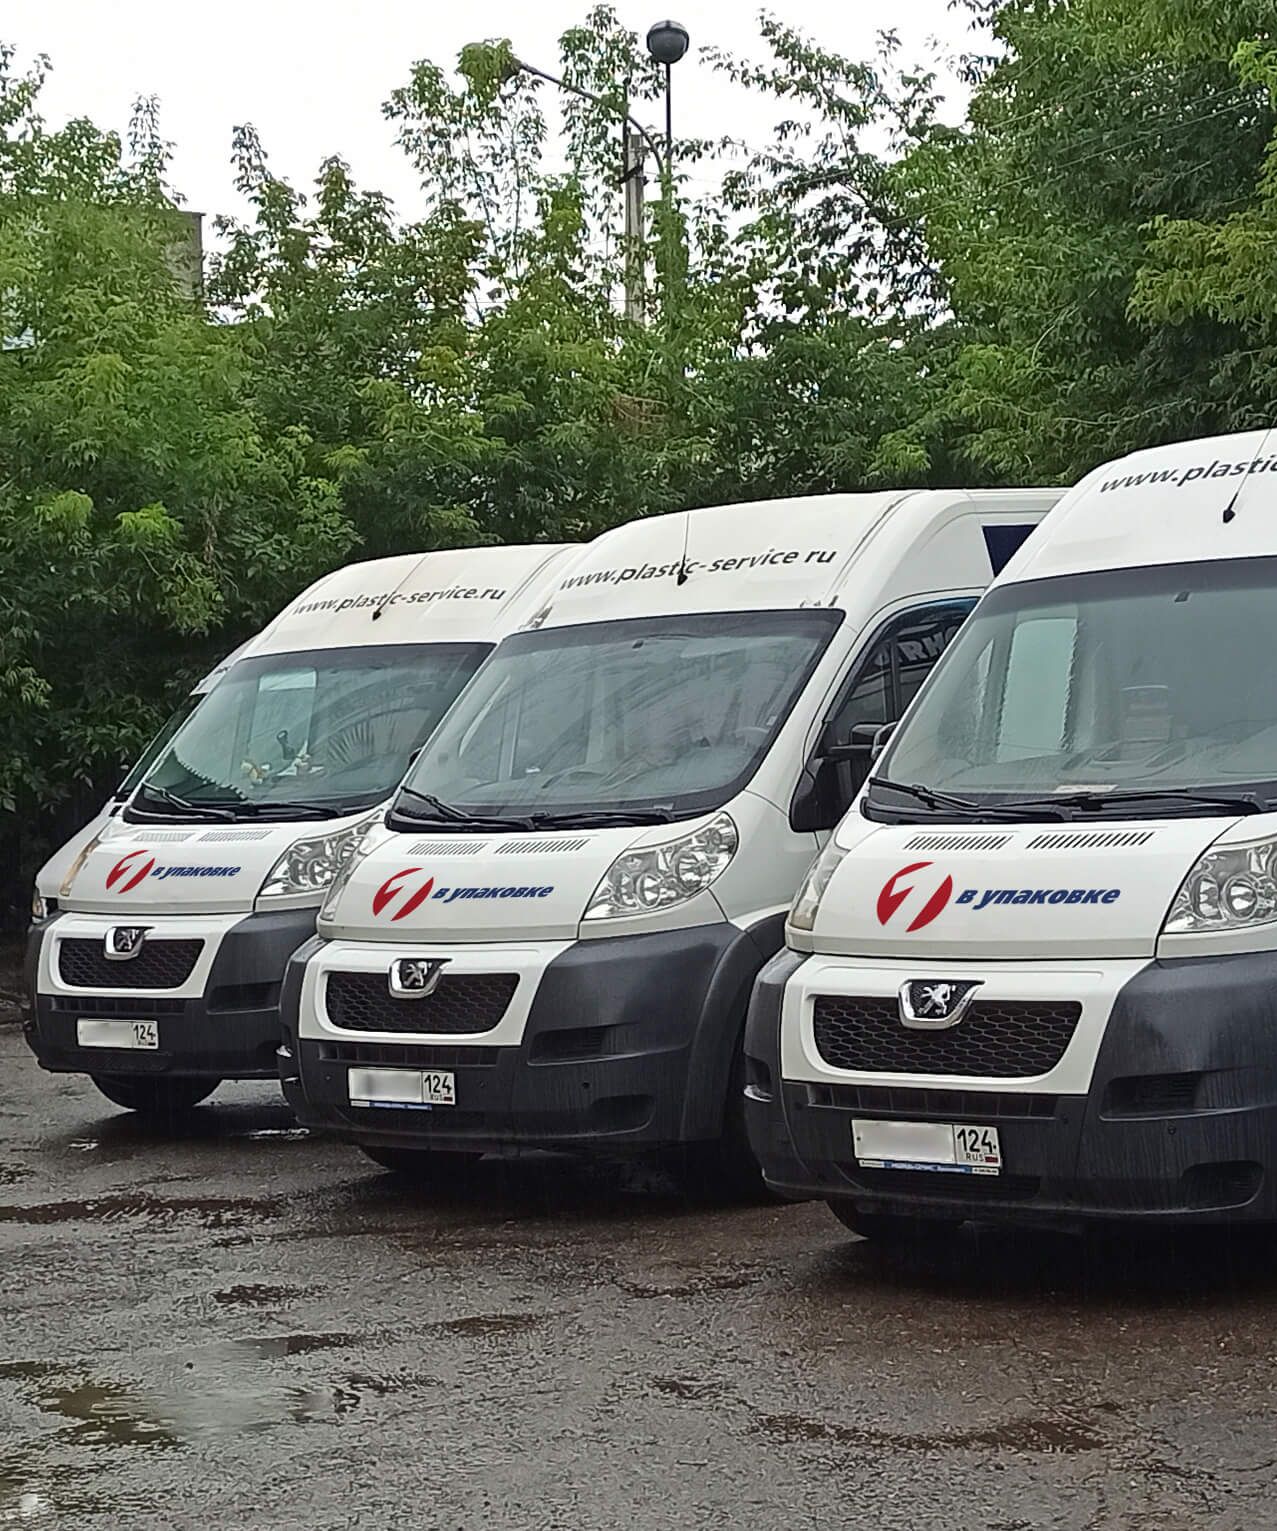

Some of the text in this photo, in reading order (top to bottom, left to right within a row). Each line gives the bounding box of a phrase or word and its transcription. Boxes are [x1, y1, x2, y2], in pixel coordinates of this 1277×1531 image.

[293, 585, 508, 616] www.plastc-service.ru
[158, 865, 242, 881] упаковке
[442, 885, 555, 904] упаковке
[954, 889, 979, 905] в
[972, 887, 1122, 910] упаковке
[133, 1023, 154, 1040] 124
[423, 1073, 452, 1094] 124
[956, 1127, 993, 1154] 124
[965, 1152, 985, 1162] RUS
